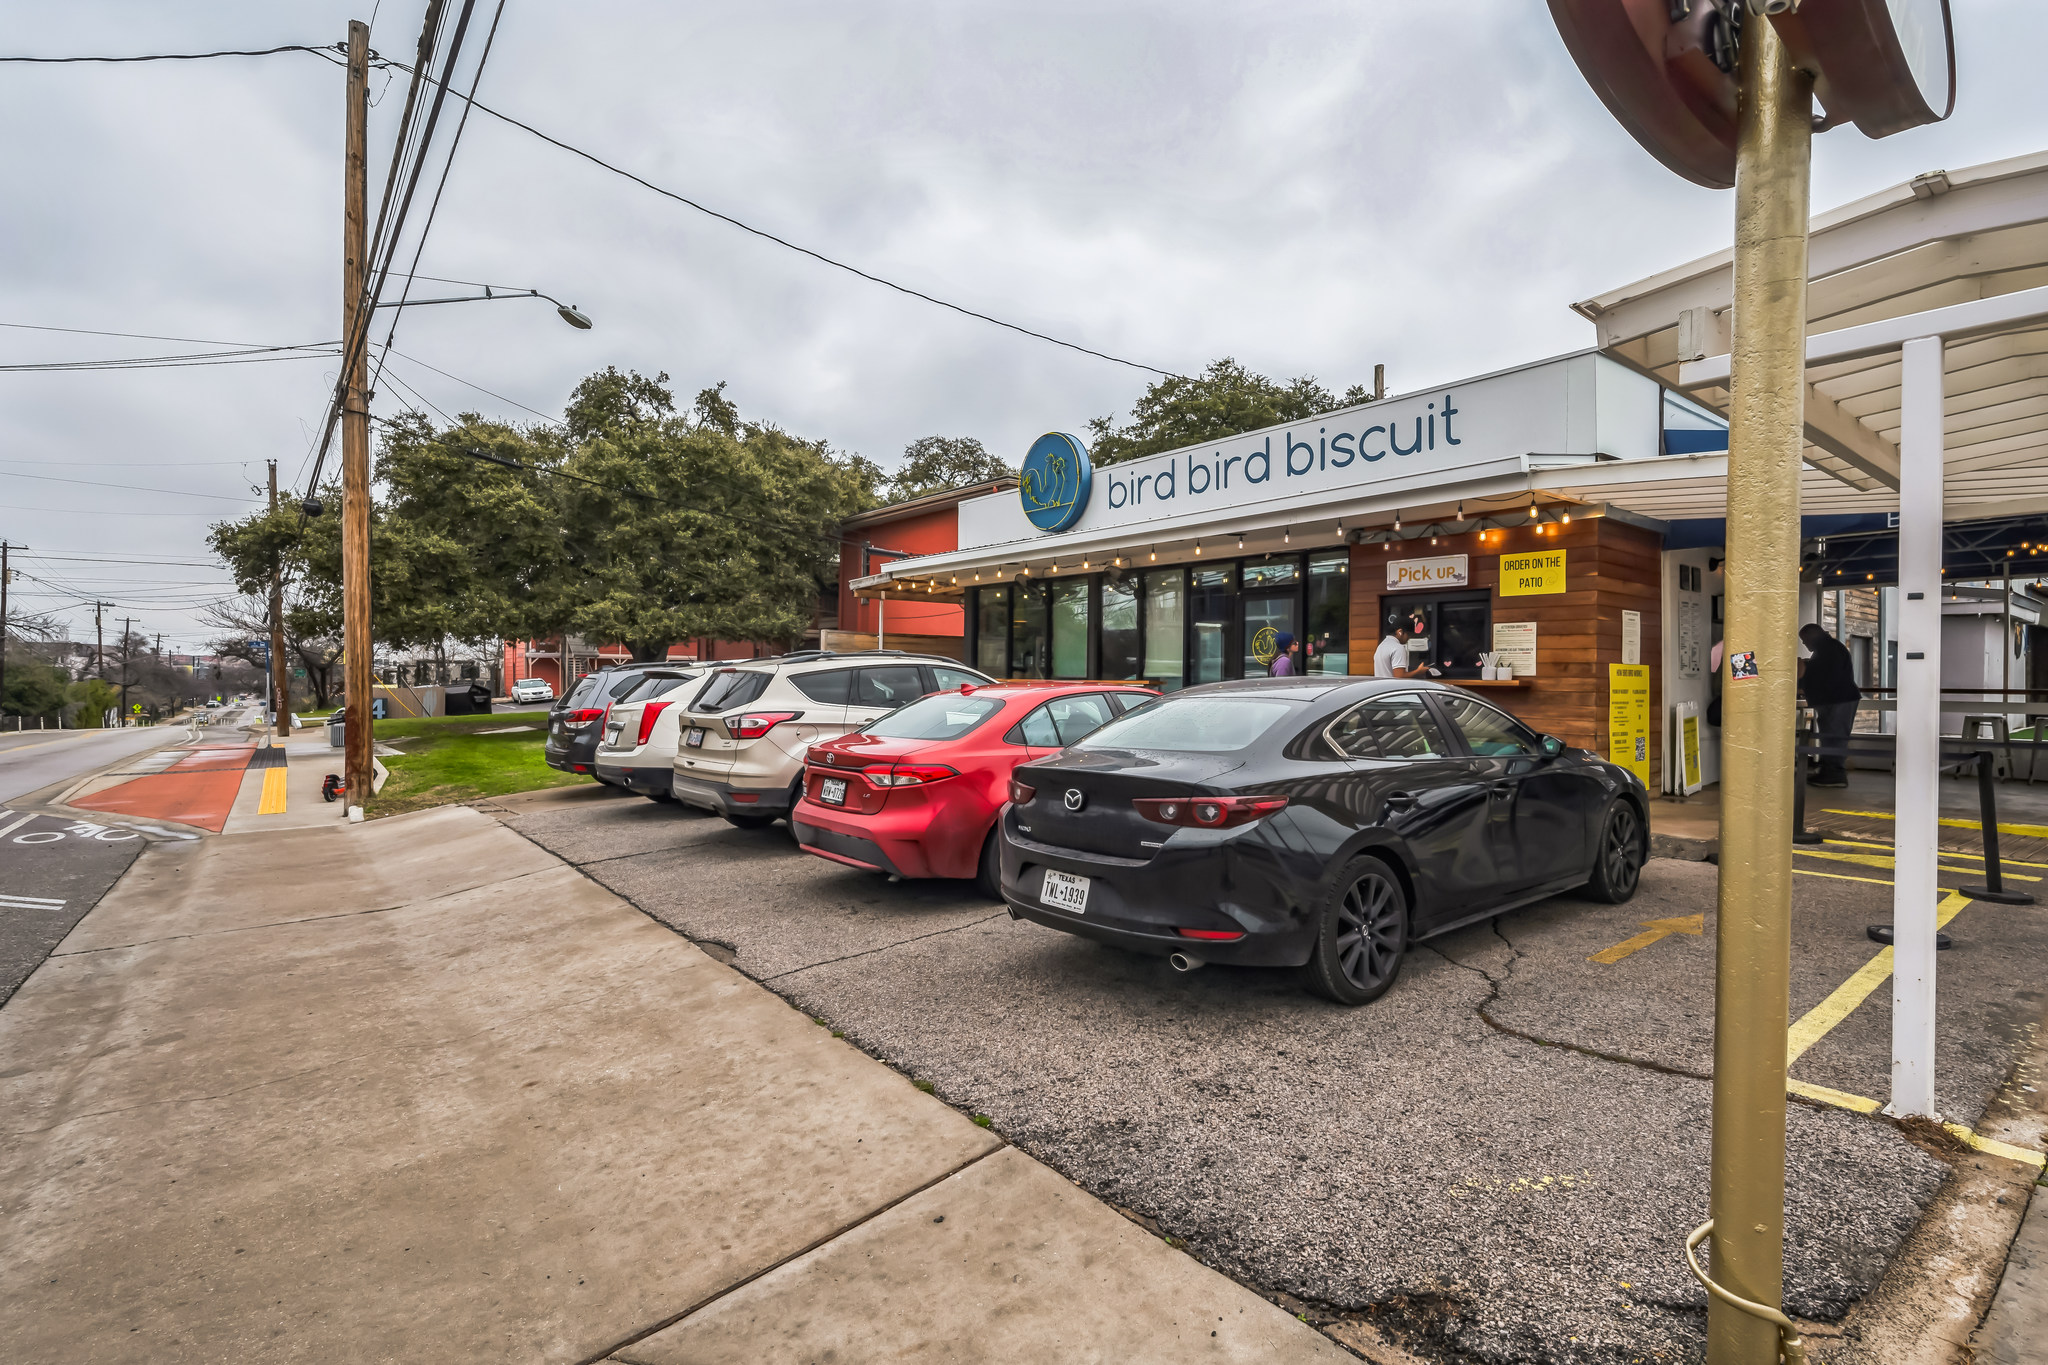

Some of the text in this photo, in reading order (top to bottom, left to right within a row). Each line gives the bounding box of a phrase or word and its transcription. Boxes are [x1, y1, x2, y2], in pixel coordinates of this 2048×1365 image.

[1108, 394, 1462, 510] bird bird biscuit
[1504, 556, 1561, 571] ORDER ON THE
[1398, 565, 1432, 582] Pick
[1519, 576, 1543, 588] PATIO
[1058, 874, 1076, 884] TEXAS
